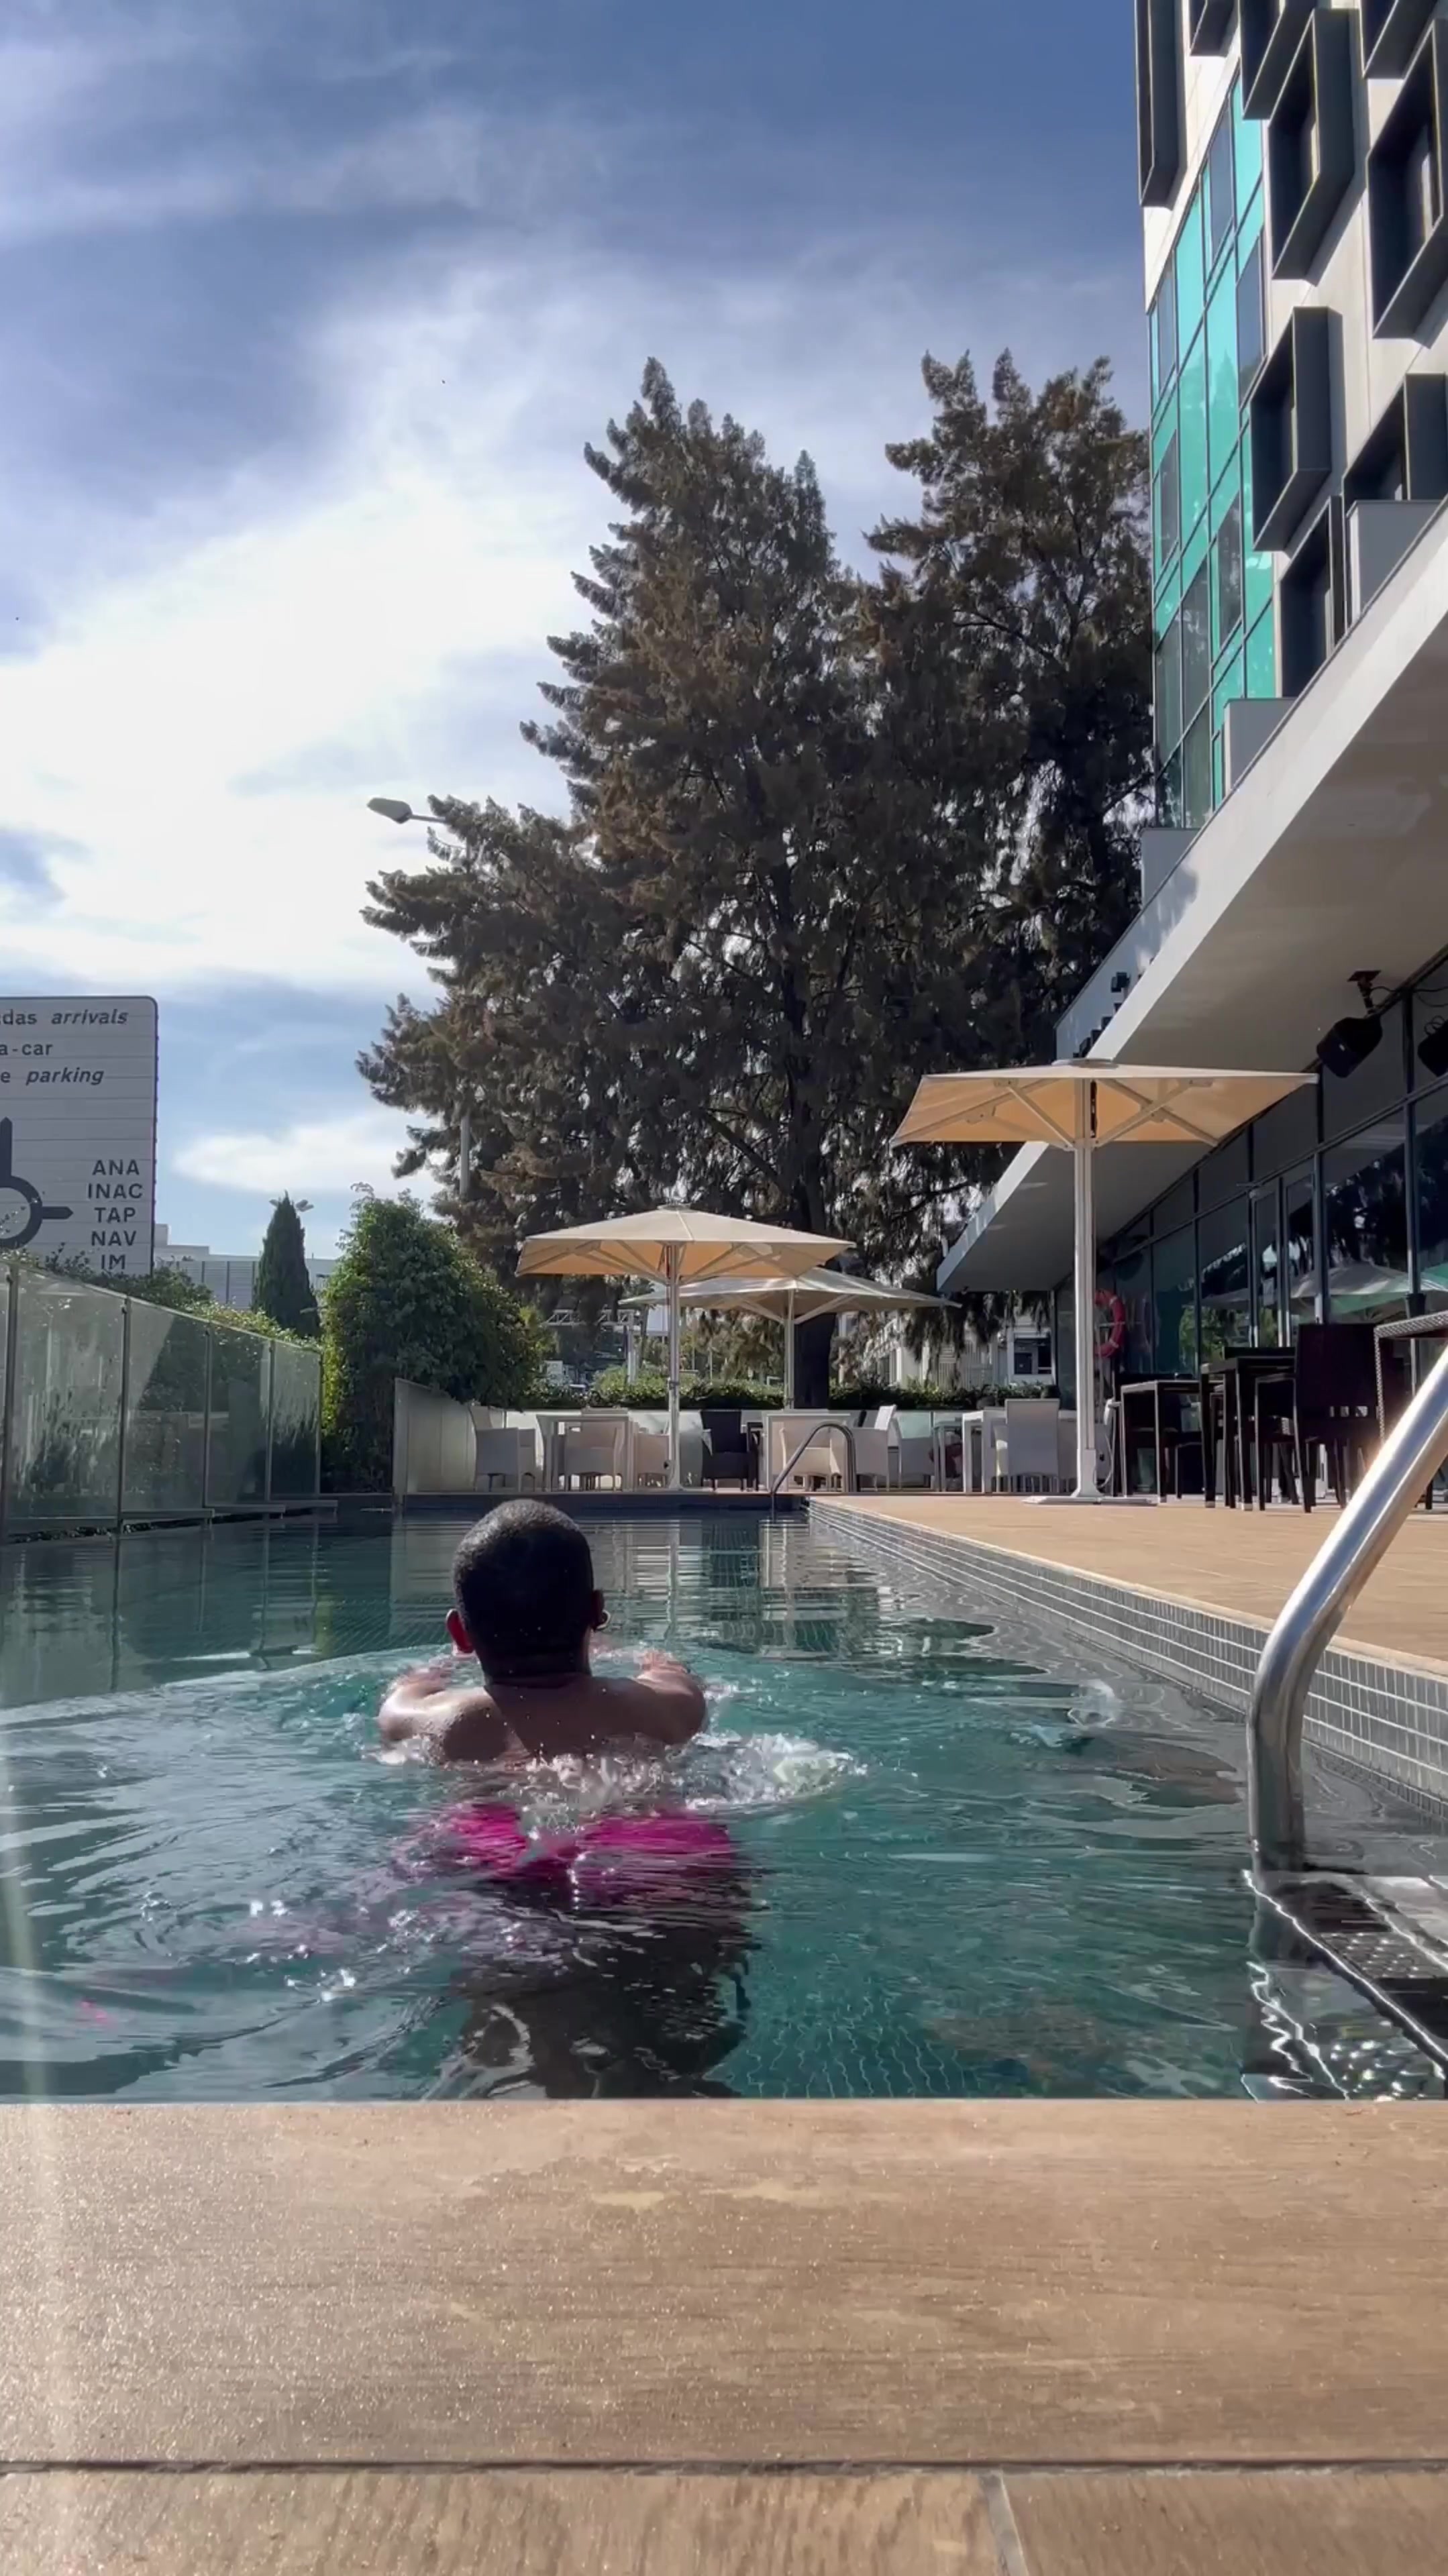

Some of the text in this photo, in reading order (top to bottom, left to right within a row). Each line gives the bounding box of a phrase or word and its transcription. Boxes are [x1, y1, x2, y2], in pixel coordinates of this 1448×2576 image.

[0, 1008, 129, 1025] das arrivals
[0, 1043, 53, 1055] a-car
[25, 1067, 104, 1086] parking
[92, 1159, 140, 1175] ANA
[88, 1183, 143, 1199] INAC
[94, 1207, 136, 1223] TAP
[91, 1230, 137, 1246] NAV
[101, 1254, 125, 1270] IM
